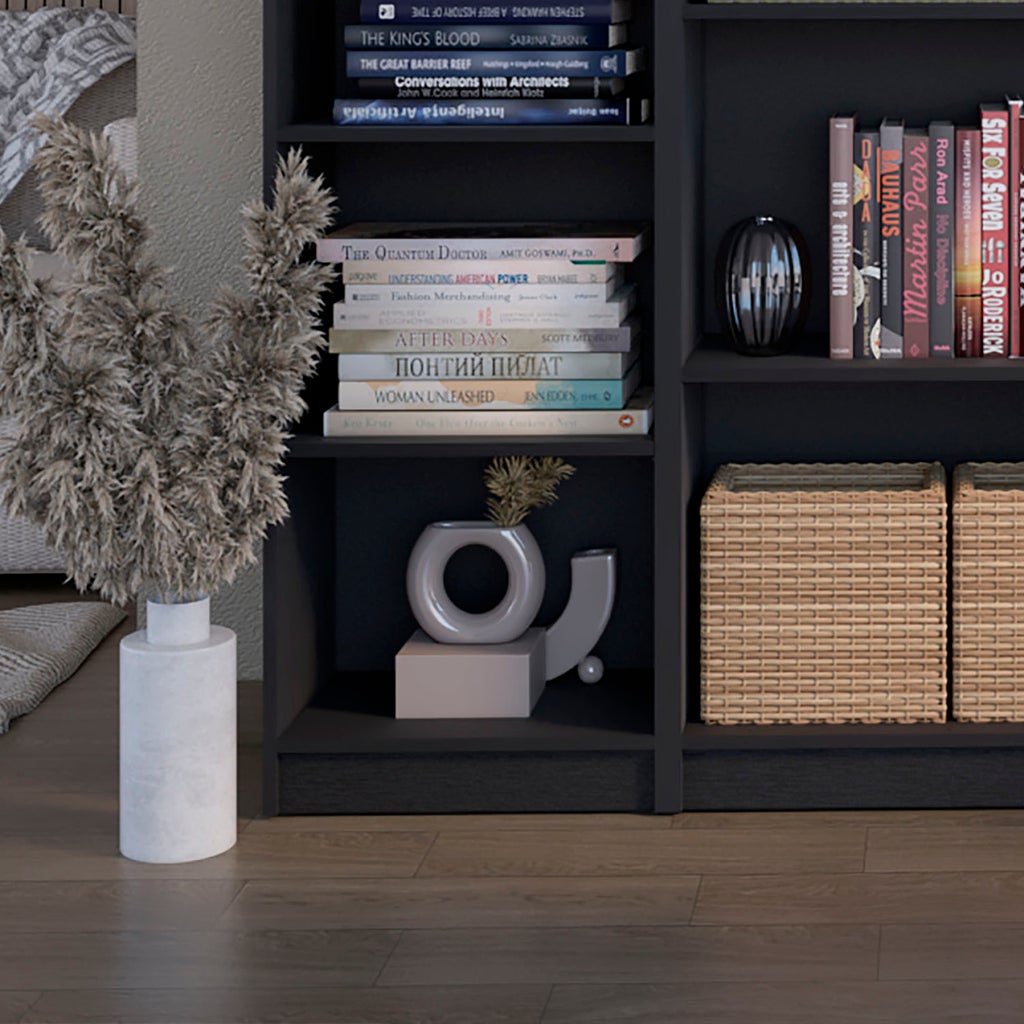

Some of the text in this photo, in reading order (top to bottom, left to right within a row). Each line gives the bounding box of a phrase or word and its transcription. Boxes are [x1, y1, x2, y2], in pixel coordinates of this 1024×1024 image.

[360, 30, 480, 47] THE KING'S BLOOD
[360, 58, 472, 70] THE GREAT BARRIER REEF
[395, 76, 570, 87] Conversations with Architects
[397, 88, 417, 99] John
[460, 88, 480, 99] and
[936, 139, 949, 204] Ron Arad
[861, 139, 872, 223] DADA
[882, 149, 900, 237] BAUHAUS
[832, 181, 850, 296] arts architecture
[904, 142, 928, 323] Martin Parr
[342, 246, 488, 260] THE QUANTUM DOCTOR
[500, 249, 523, 259] AMIT
[388, 274, 454, 284] UNDERSTANDING
[455, 274, 496, 284] AMERICAN
[497, 274, 529, 284] POWER
[391, 291, 511, 302] Fashion Merchandising
[395, 332, 508, 347] AFTER DAYS
[541, 334, 570, 343] SCOTT
[395, 352, 563, 377] ПОНТИЙ ПИЛАТ
[374, 391, 495, 404] WOMAN UNLEASHED
